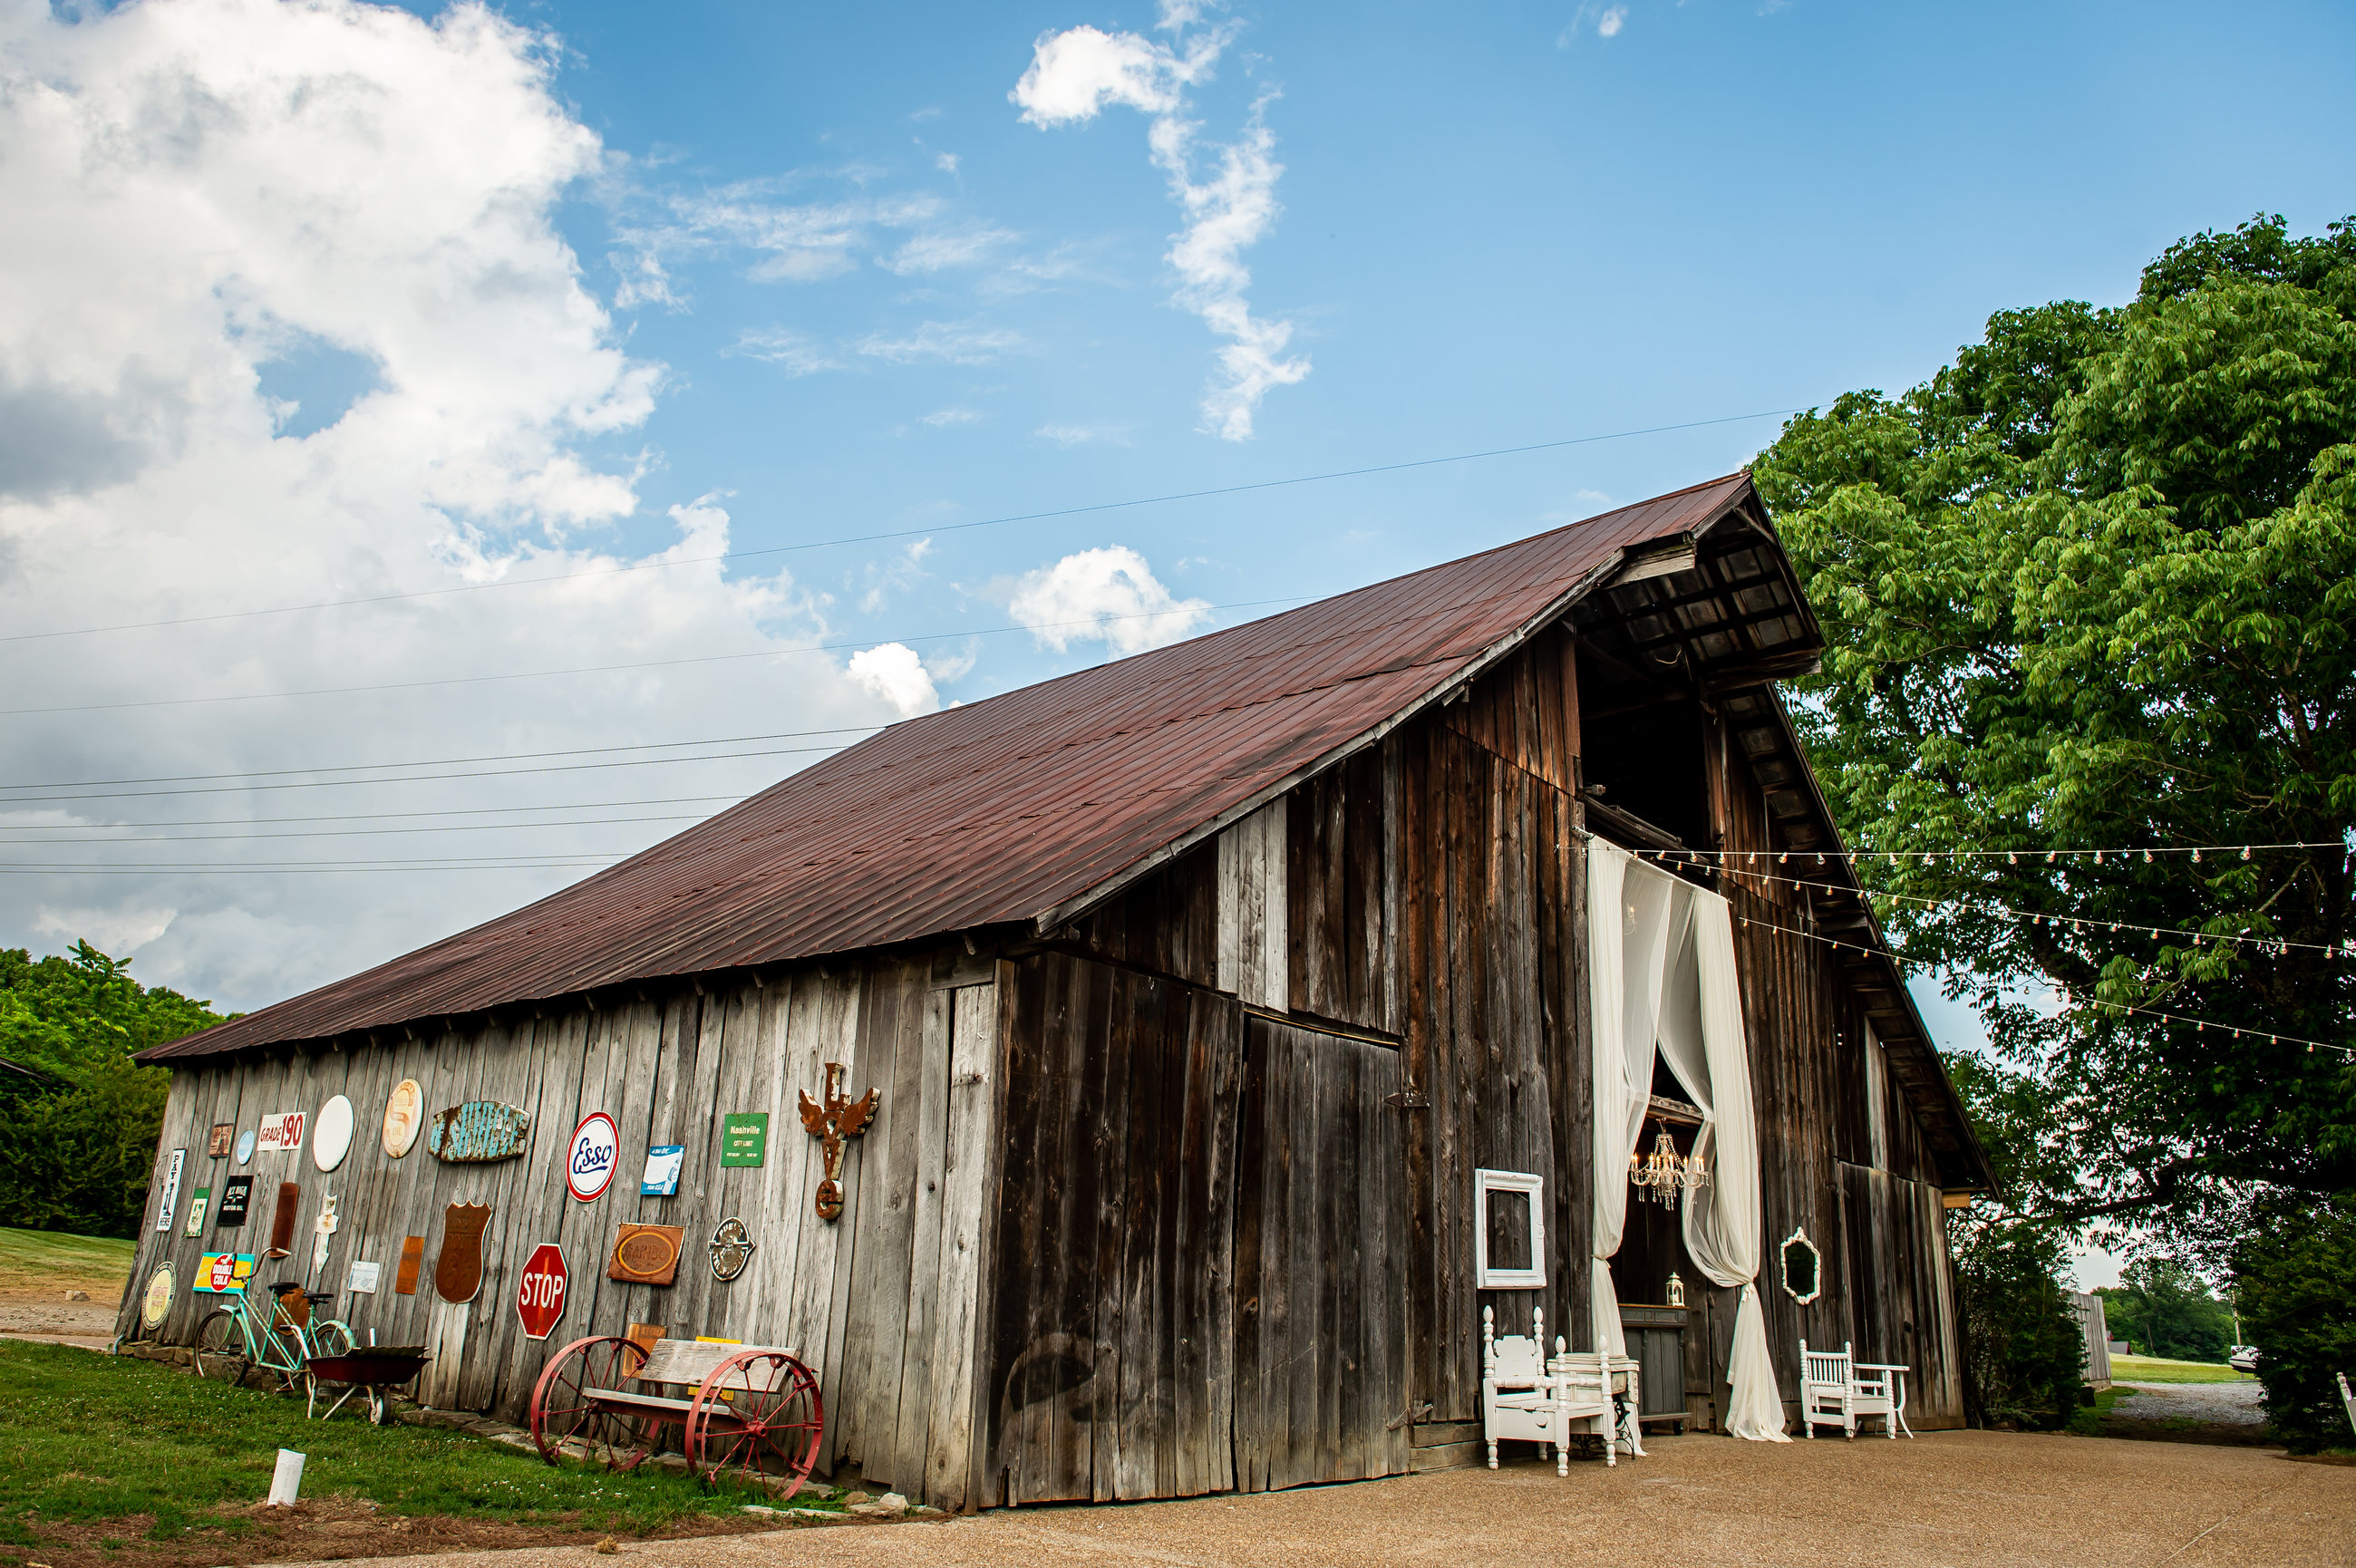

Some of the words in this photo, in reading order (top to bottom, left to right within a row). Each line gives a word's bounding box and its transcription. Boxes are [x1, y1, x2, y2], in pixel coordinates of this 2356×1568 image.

[260, 1126, 282, 1142] GRADE
[280, 1114, 304, 1147] 190
[730, 1125, 761, 1135] Nashville
[170, 1155, 179, 1180] PAY
[572, 1137, 613, 1176] Esso
[159, 1216, 170, 1226] HERE
[213, 1274, 229, 1285] COLA
[520, 1272, 564, 1310] STOP
